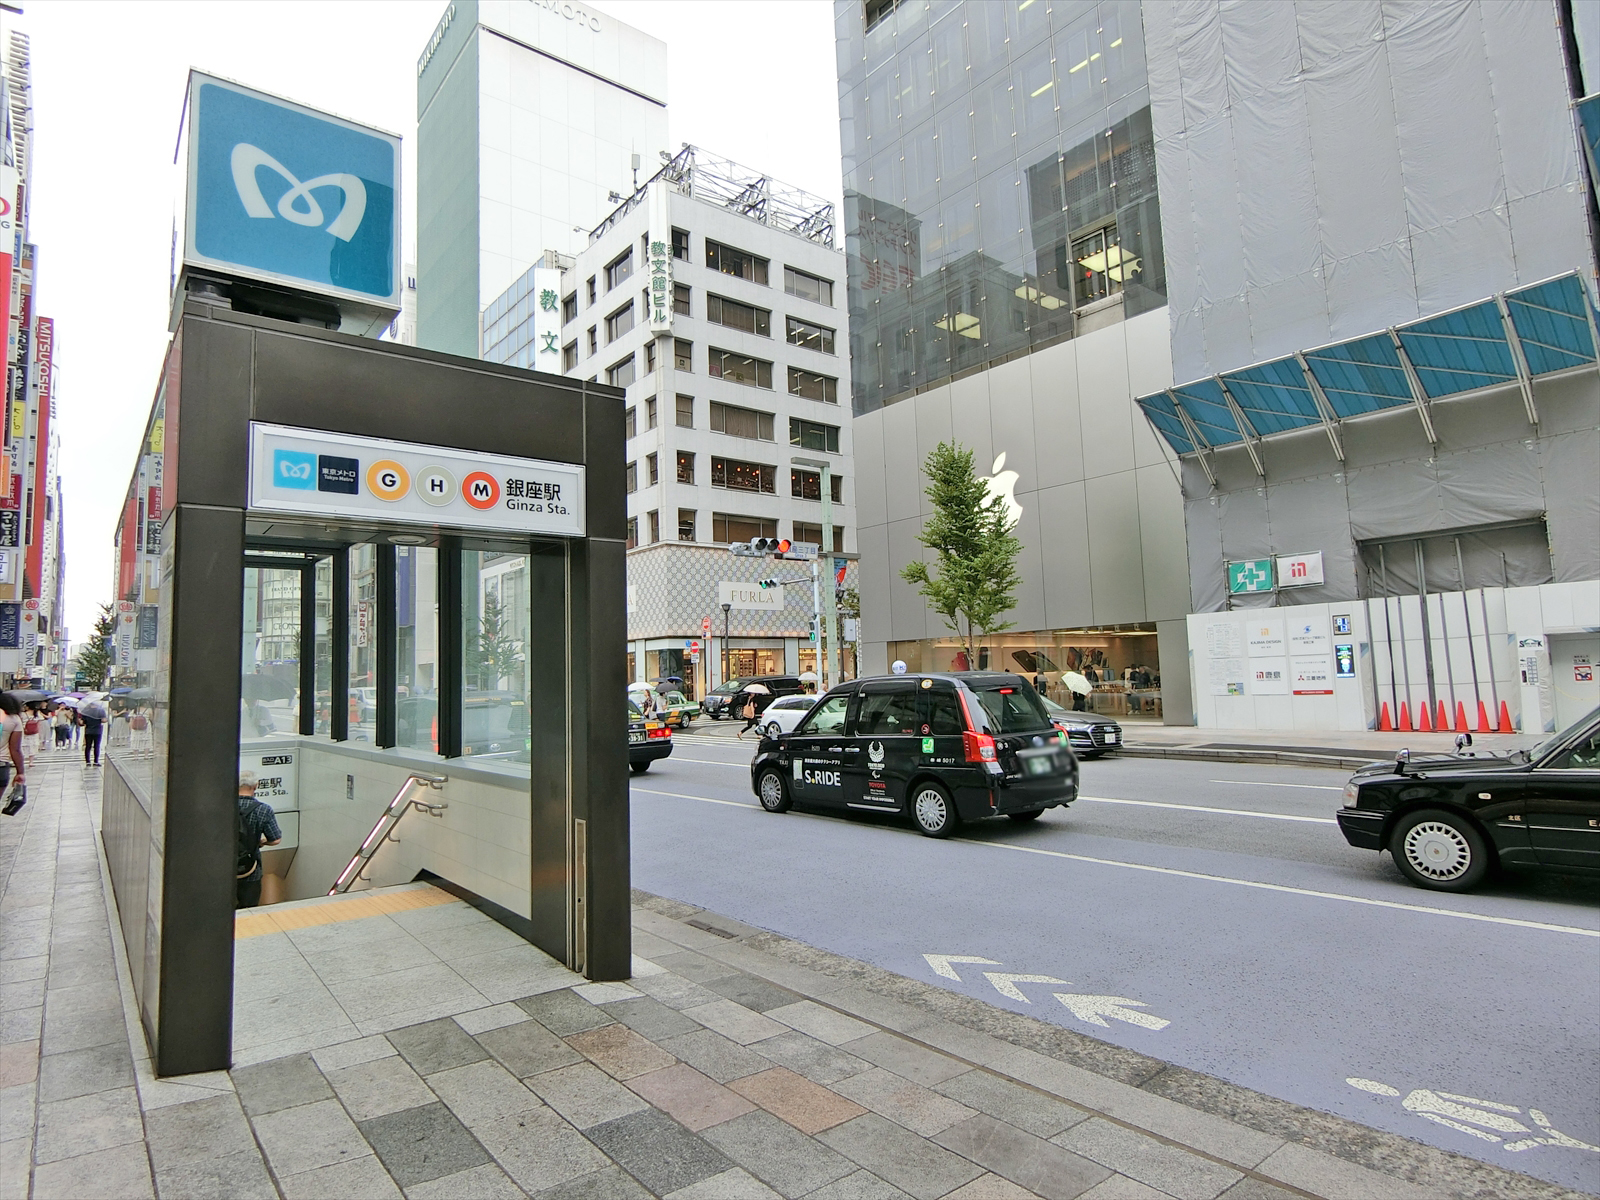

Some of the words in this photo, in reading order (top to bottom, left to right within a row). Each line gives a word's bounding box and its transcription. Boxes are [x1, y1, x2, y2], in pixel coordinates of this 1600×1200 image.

[651, 240, 667, 323] 教文館ビル
[39, 321, 52, 397] MITSUKOSHI
[321, 467, 356, 478] 東京メトロ
[381, 473, 396, 488] G
[430, 478, 444, 493] H
[473, 483, 490, 498] M
[506, 478, 561, 501] 銀座駅
[506, 499, 543, 512] Ginza
[547, 502, 570, 515] Sta.
[730, 590, 774, 603] FURLA
[274, 755, 292, 764] A13
[257, 776, 282, 790] 座駅
[804, 769, 842, 787] S.RIDE
[253, 790, 270, 798] nza
[272, 788, 289, 796] Sta.
[1588, 819, 1600, 828] E
